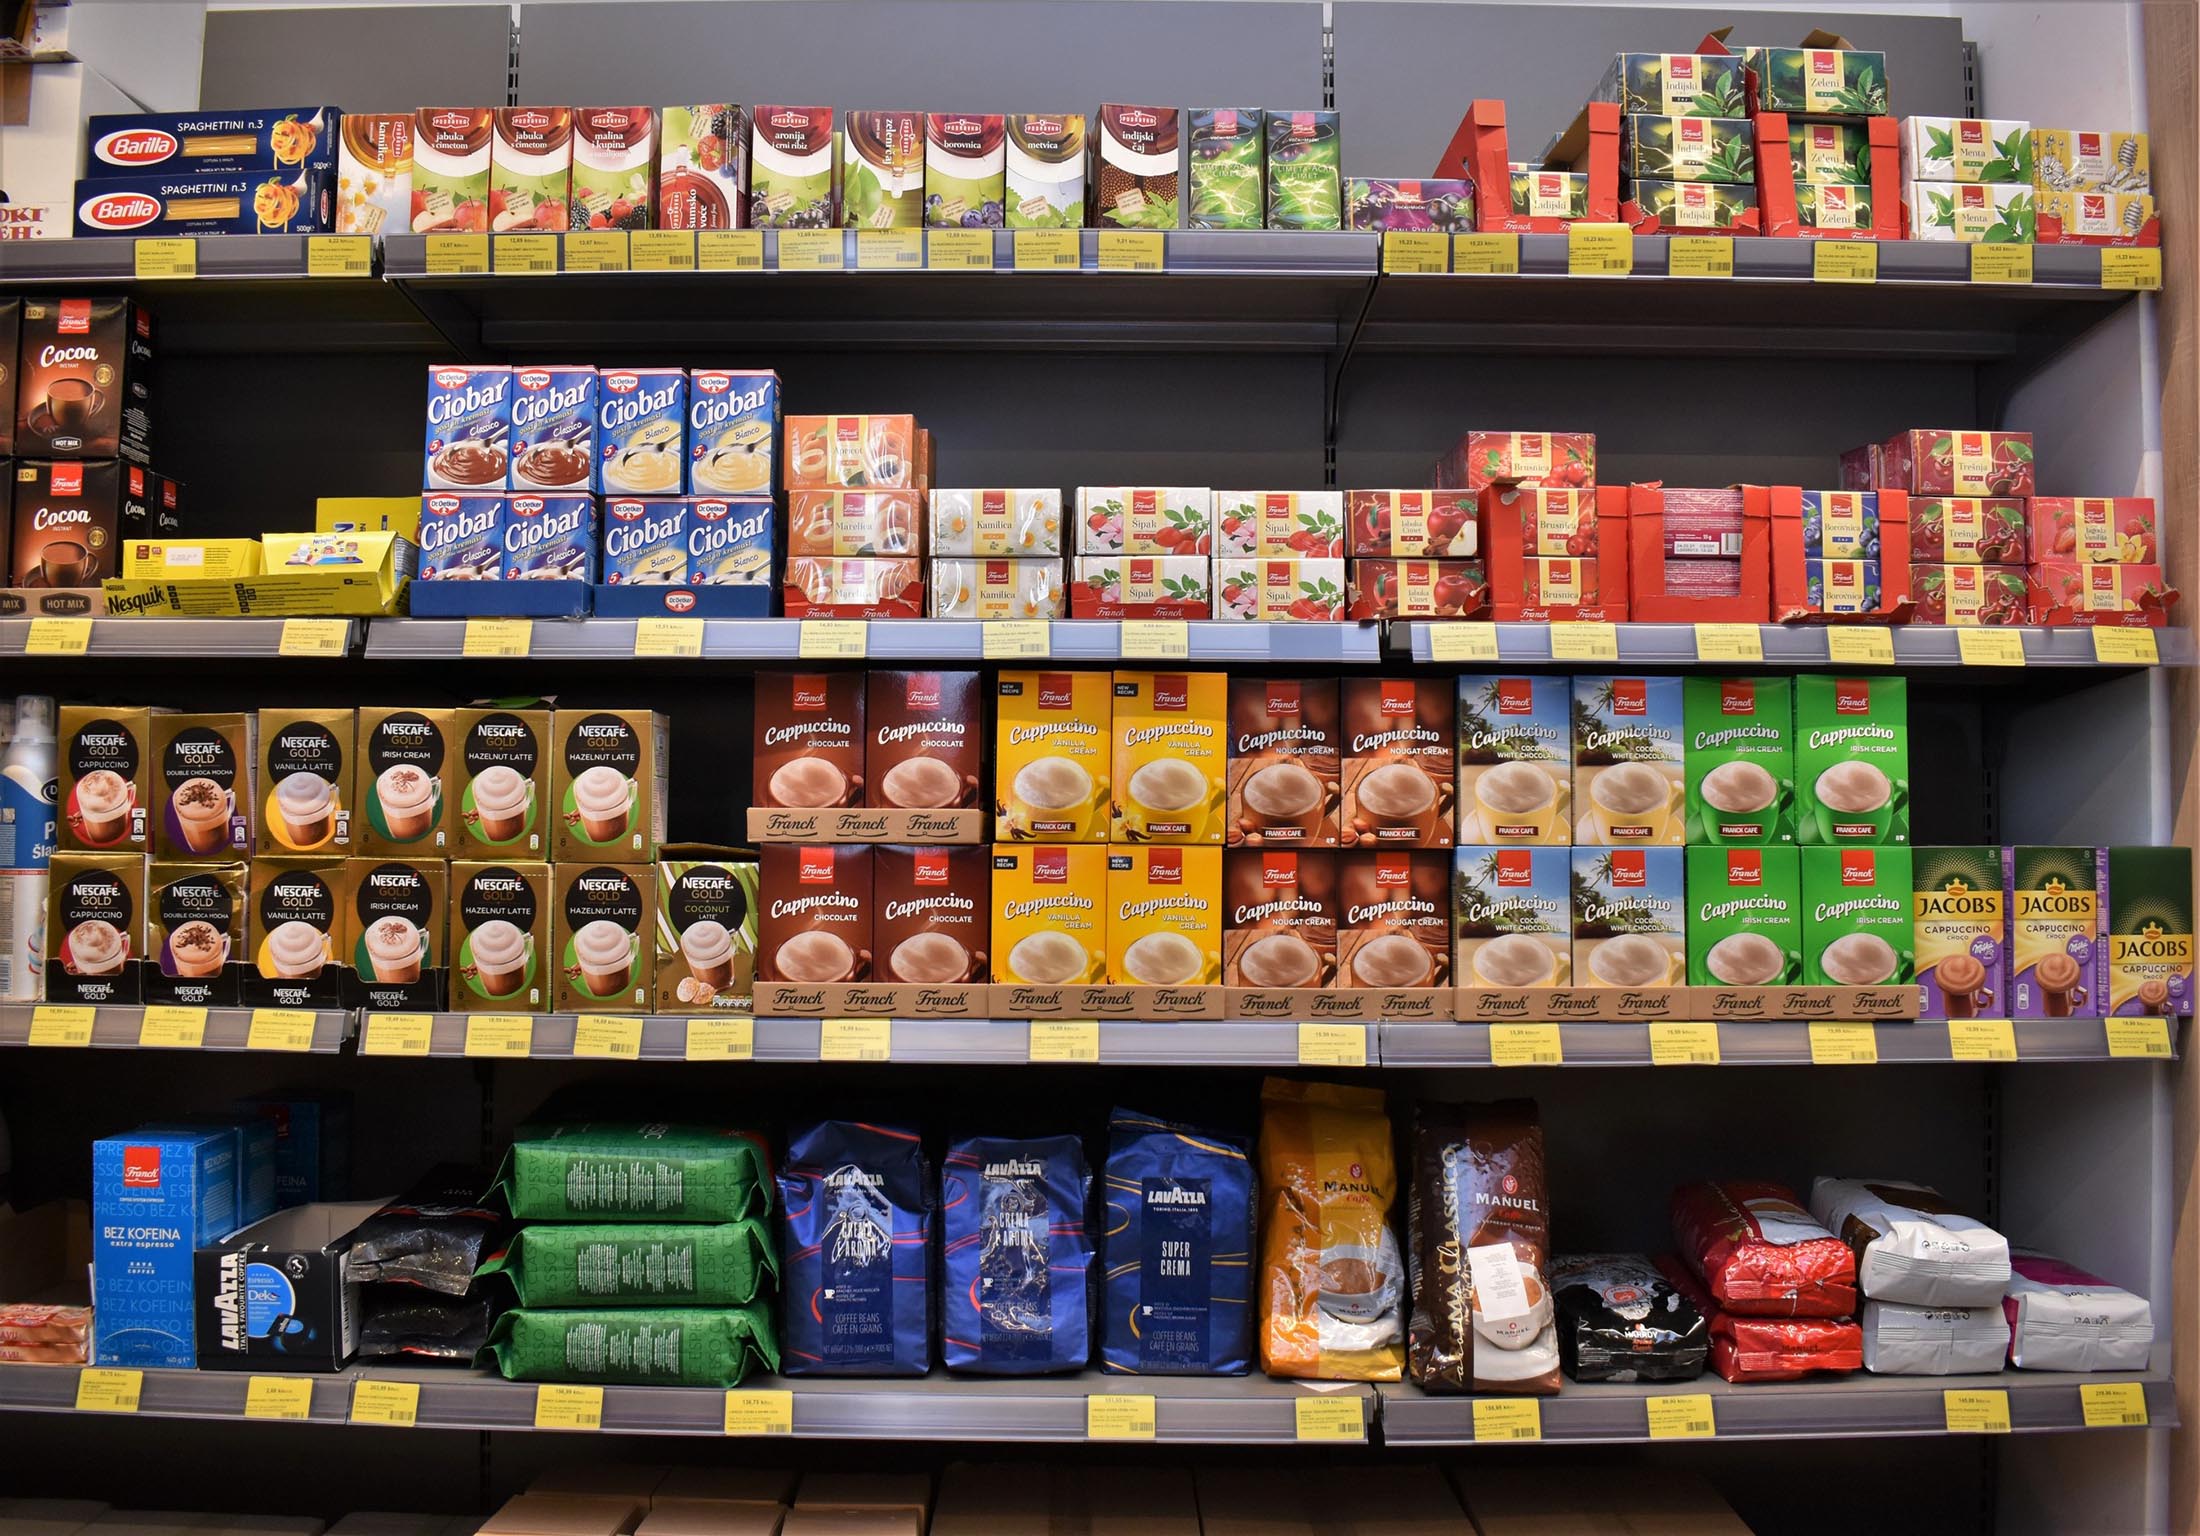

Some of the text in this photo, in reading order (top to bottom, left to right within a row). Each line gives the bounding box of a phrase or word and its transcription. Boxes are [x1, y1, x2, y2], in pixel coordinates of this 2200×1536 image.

[1666, 81, 1697, 91] Indijski
[1811, 78, 1840, 88] Zeleni
[177, 120, 263, 132] SPAGHETTINI n.3
[436, 132, 464, 142] jabuka
[515, 131, 543, 141] jabuka
[595, 133, 623, 141] malina
[775, 132, 805, 142] aronija
[1122, 132, 1154, 143] indijski
[114, 137, 170, 156] Barilla
[436, 141, 468, 150] cimetom
[516, 141, 547, 149] cimetom
[596, 141, 625, 150] kupina
[791, 141, 807, 150] ribiz
[944, 140, 981, 149] borovnica
[1028, 141, 1058, 149] metvica
[1132, 142, 1145, 153] čaj
[1960, 148, 1985, 157] Menta
[161, 182, 246, 195] SPAGHETTINI n.3
[97, 200, 152, 219] Barilla
[1680, 211, 1710, 222] Indijski
[1822, 214, 1850, 224] Zeleni
[1962, 213, 1987, 222] Menta
[40, 345, 98, 368] Cocoa
[427, 377, 508, 425] Ciobar
[512, 377, 591, 427] Ciobar
[601, 380, 680, 429] Ciobar
[691, 381, 771, 430] Ciobar
[469, 420, 499, 437] Classico
[553, 422, 582, 438] Classico
[645, 425, 670, 441] Bianco
[735, 426, 760, 441] Bianco
[1514, 463, 1549, 472] Brusnica
[1958, 462, 1988, 473] Trešnja
[125, 500, 145, 517] Cocoa
[33, 507, 91, 531] Cocoa
[1132, 518, 1157, 529] Šipak
[420, 504, 501, 552] Ciobar
[977, 520, 1012, 530] Kamilica
[1265, 522, 1290, 533] Šipak
[1824, 523, 1861, 532] Borovnica
[1949, 529, 1979, 540] Trešnja
[980, 591, 1016, 599] Kamilica
[1129, 588, 1154, 599] Šipak
[1542, 590, 1579, 599] Brusnica
[1826, 592, 1862, 601] Borovnica
[46, 599, 85, 609] HOT MIX
[108, 585, 165, 615] Nesquik
[1951, 596, 1981, 607] Trešnja
[805, 609, 834, 618] Franck
[795, 692, 825, 702] Franck
[383, 721, 432, 736] NESCAFÉ
[477, 722, 526, 737] NESCAFÉ
[765, 717, 851, 746] Cappuccino
[1010, 718, 1097, 745] Cappuccino
[81, 732, 127, 747] NESCAFÉ
[281, 733, 330, 749] NESCAFÉ
[1239, 725, 1326, 752] Cappuccino
[1472, 723, 1557, 749] Cappuccino
[90, 746, 118, 756] GOLD
[176, 739, 224, 755] NESCAFÉ
[289, 748, 321, 758] GOLD
[382, 751, 430, 759] IRISH CREAM
[468, 752, 533, 761] HAZELNUT LATTE
[184, 755, 215, 764] GOLD
[275, 762, 333, 771] VANILLA LATTE
[766, 814, 818, 830] Franck
[81, 897, 112, 906] GOLD
[886, 892, 974, 920] Cappuccino
[1120, 893, 1208, 920] Cappuccino
[1920, 897, 1996, 916] JACOBS
[2021, 897, 2090, 915] JACOBS
[684, 904, 730, 914] COCONUT
[1348, 896, 1435, 924] Cappuccino
[70, 911, 123, 919] CAPPUCCINO
[1925, 926, 1990, 934] CAPPUCCINO
[2026, 925, 2085, 933] CAPPUCCINO
[2117, 941, 2187, 959] JACOBS
[2122, 965, 2183, 973] CAPPUCCINO
[773, 989, 826, 1005] Franck
[1082, 989, 1134, 1005] Franck
[1382, 994, 1434, 1010] Franck
[1477, 993, 1530, 1009] Franck
[1853, 993, 1904, 1009] Franck
[125, 1167, 159, 1178] Franck
[984, 1159, 1042, 1175] LAVAZZA
[827, 1174, 884, 1187] LAVAZZA
[1148, 1187, 1206, 1204] LAVAZZA
[1476, 1192, 1539, 1212] MANUEL
[999, 1212, 1029, 1227] CREMA
[104, 1227, 181, 1240] BEZ KOFEINA
[1003, 1231, 1034, 1247] AROMA
[136, 1241, 174, 1249] espresso
[1162, 1241, 1190, 1258] SUPER
[1160, 1259, 1191, 1277] CREMA
[214, 1253, 239, 1350] LAVAZZA
[835, 1313, 880, 1323] COFFEE BEANS
[850, 1324, 858, 1334] EN
[859, 1324, 883, 1334] GRAINS
[1152, 1331, 1197, 1340] COFFEE BEANS
